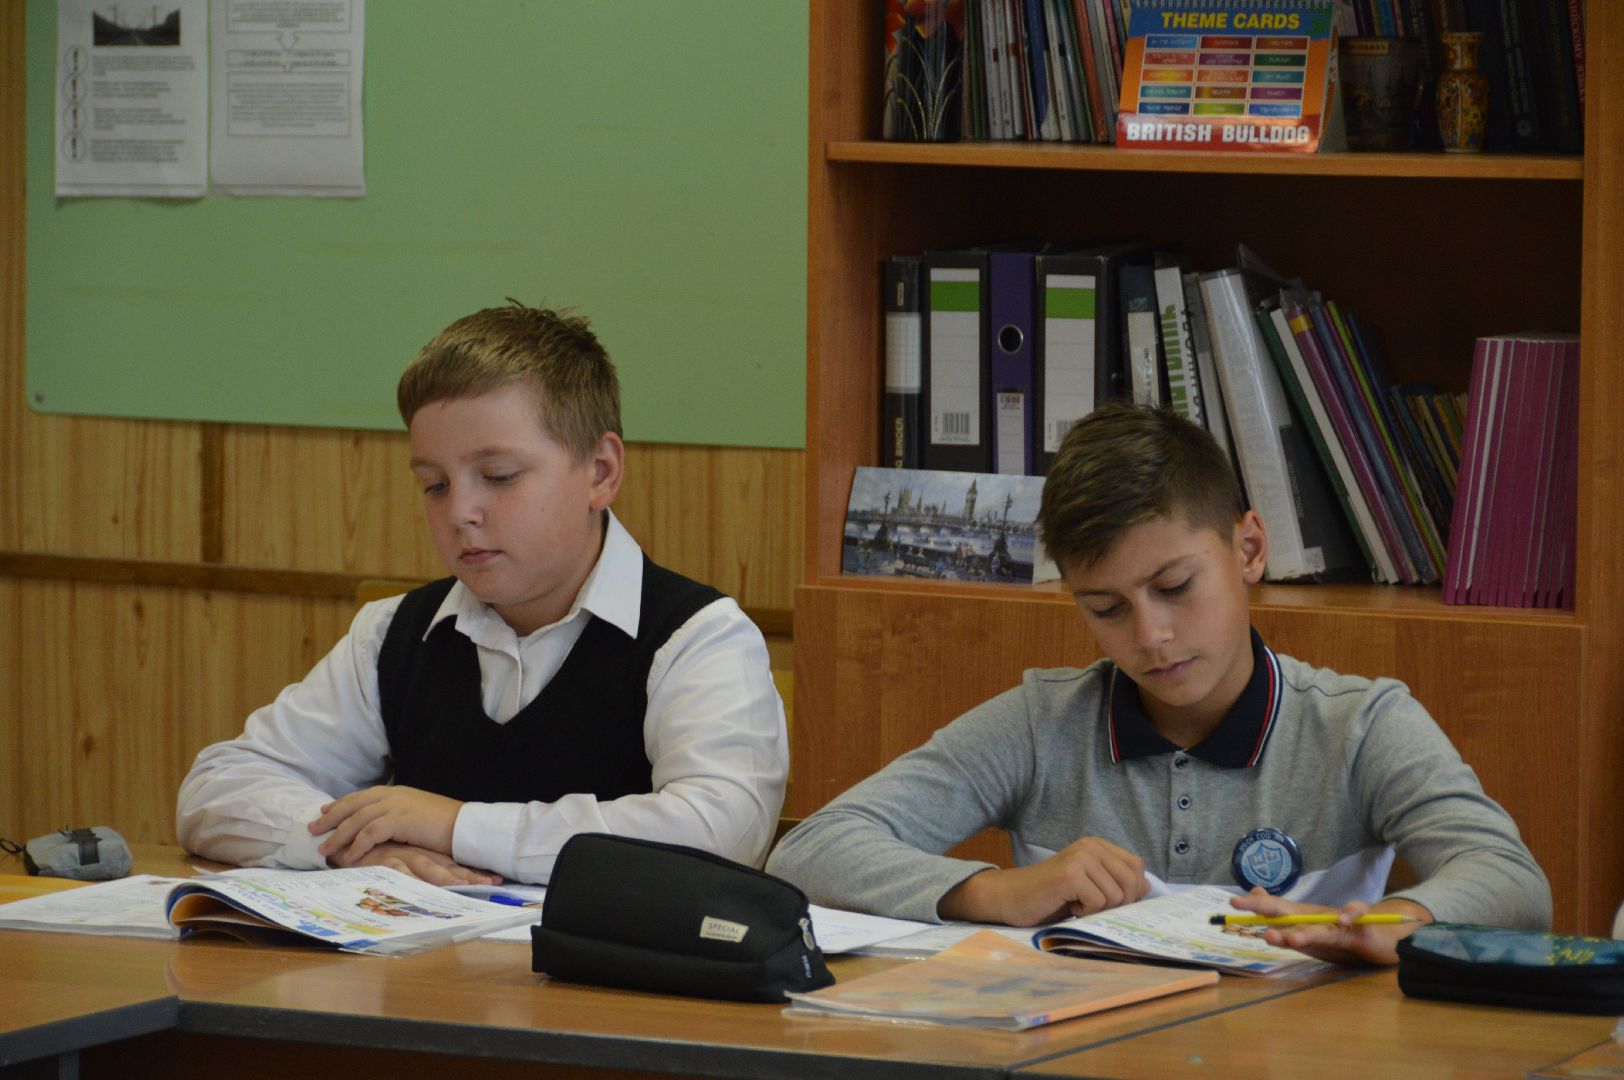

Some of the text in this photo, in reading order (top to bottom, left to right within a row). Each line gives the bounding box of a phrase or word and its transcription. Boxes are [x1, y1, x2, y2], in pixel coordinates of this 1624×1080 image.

[1161, 12, 1300, 29] THEME CARDS
[1127, 122, 1310, 144] BRITISH BULLDOG
[895, 417, 904, 456] BINDER
[1256, 832, 1272, 840] СОШ
[708, 922, 740, 934] SPECIAL
